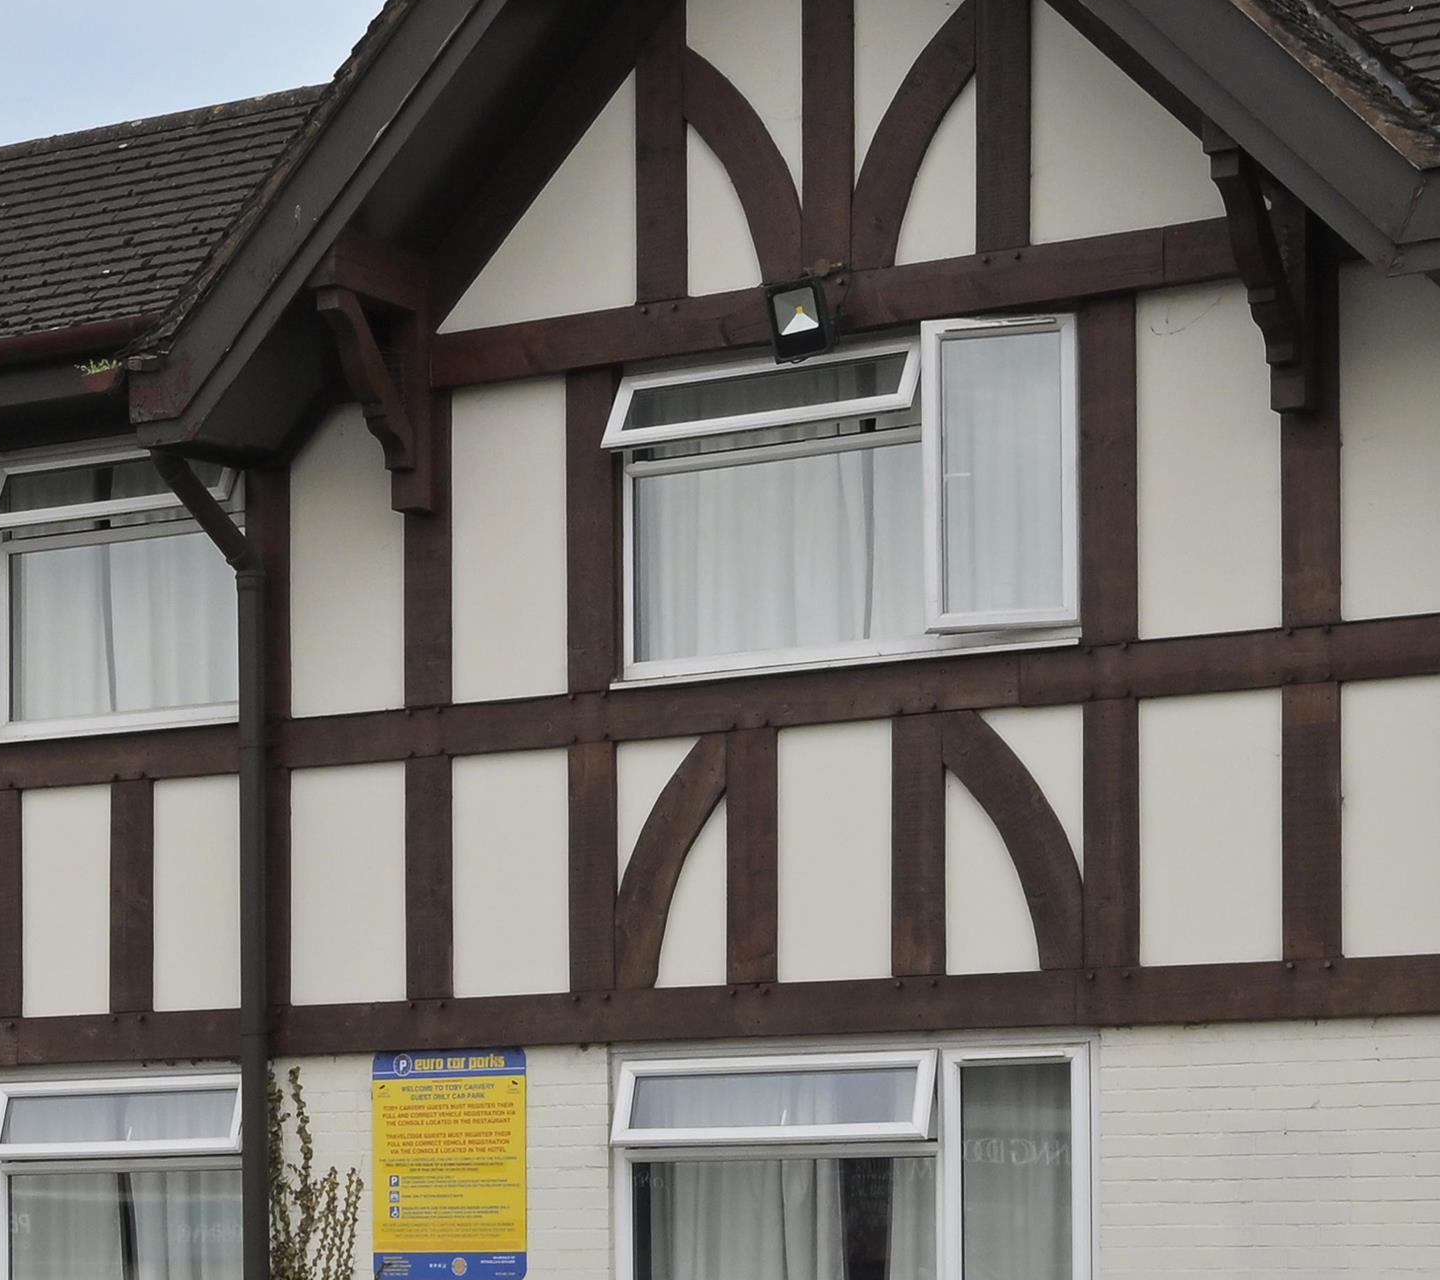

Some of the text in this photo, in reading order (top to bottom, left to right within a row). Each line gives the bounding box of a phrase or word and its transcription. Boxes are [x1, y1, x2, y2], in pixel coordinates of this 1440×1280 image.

[414, 1058, 444, 1071] euro
[447, 1057, 466, 1070] car
[468, 1053, 505, 1072] parks
